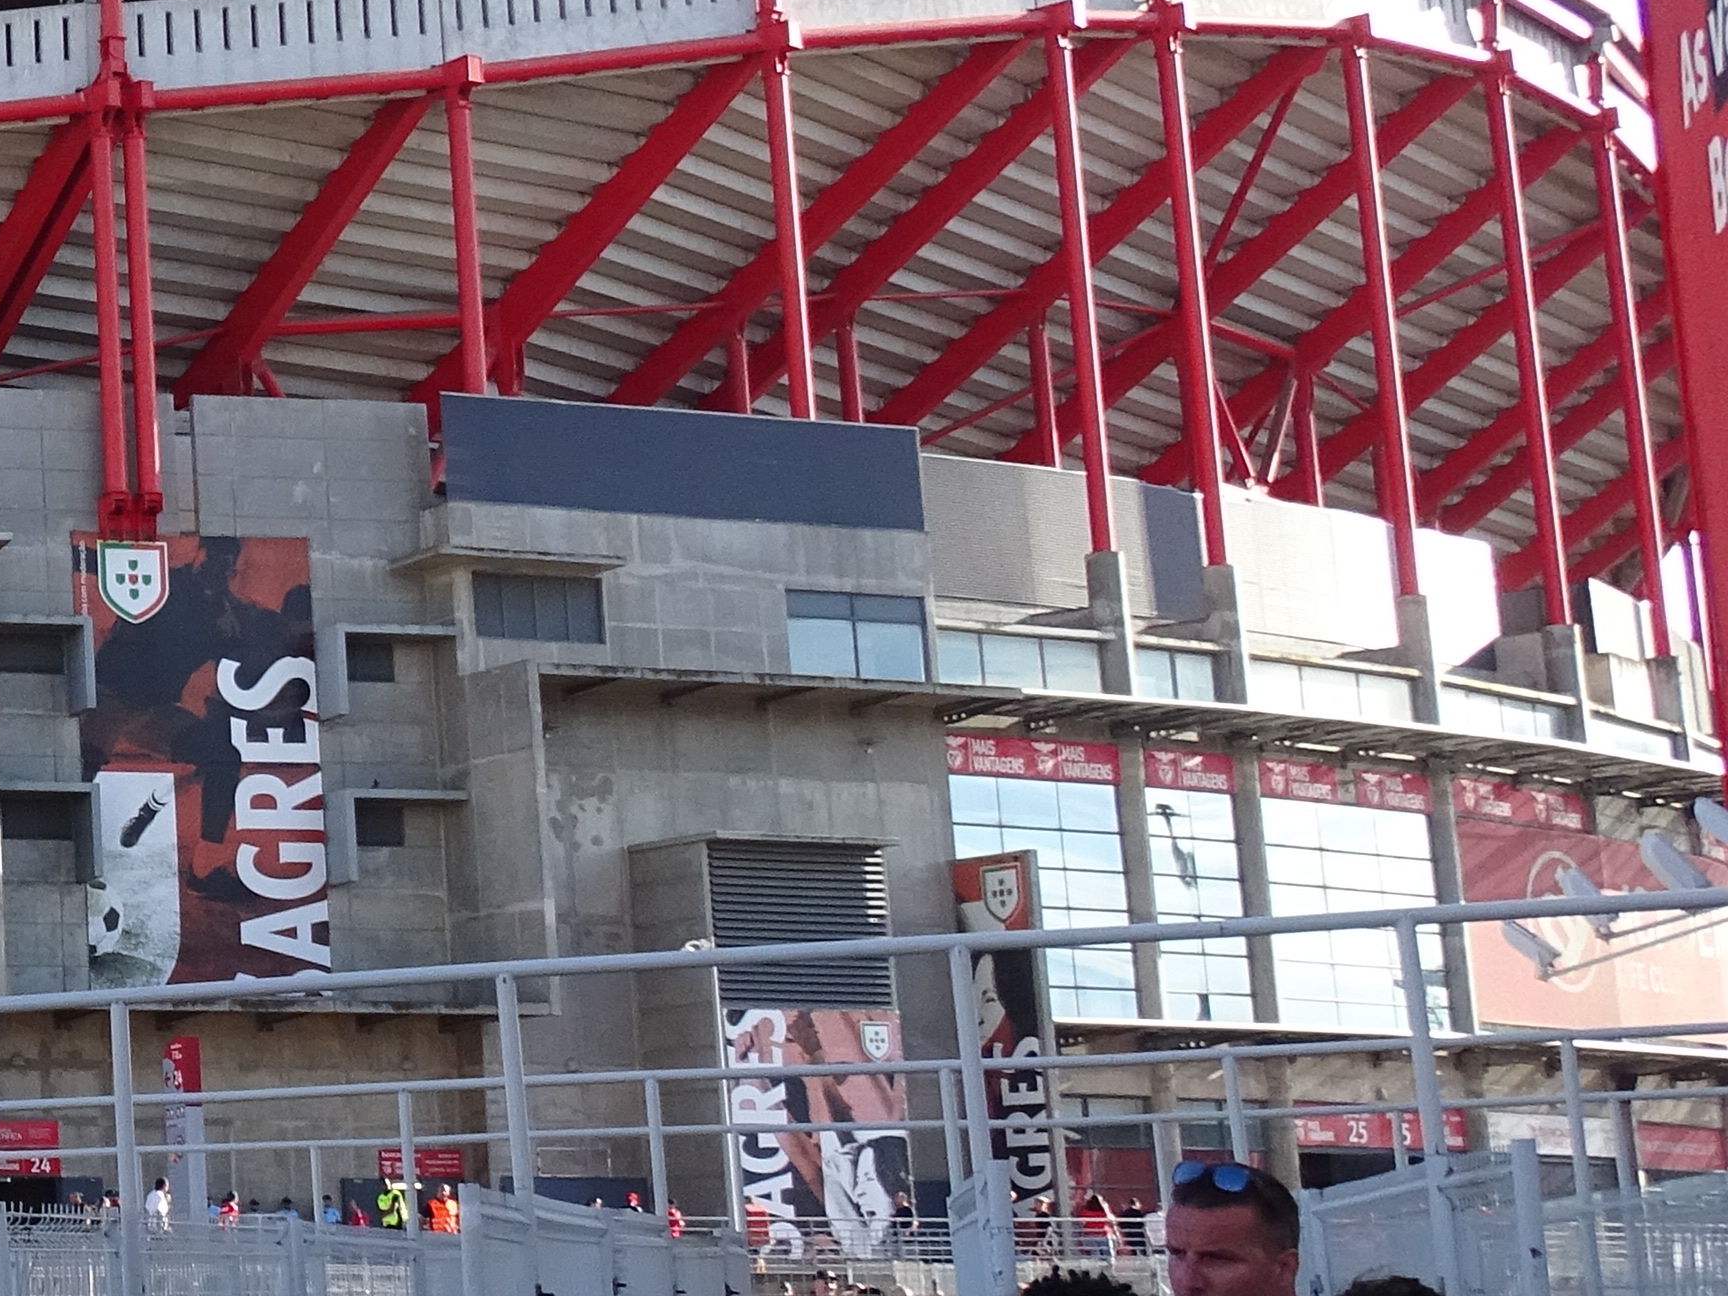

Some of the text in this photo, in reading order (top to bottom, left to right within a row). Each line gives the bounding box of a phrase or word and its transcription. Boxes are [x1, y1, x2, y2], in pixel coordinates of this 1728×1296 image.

[217, 656, 332, 996] AGRES
[1347, 1120, 1367, 1144] 25
[30, 1157, 52, 1173] 24
